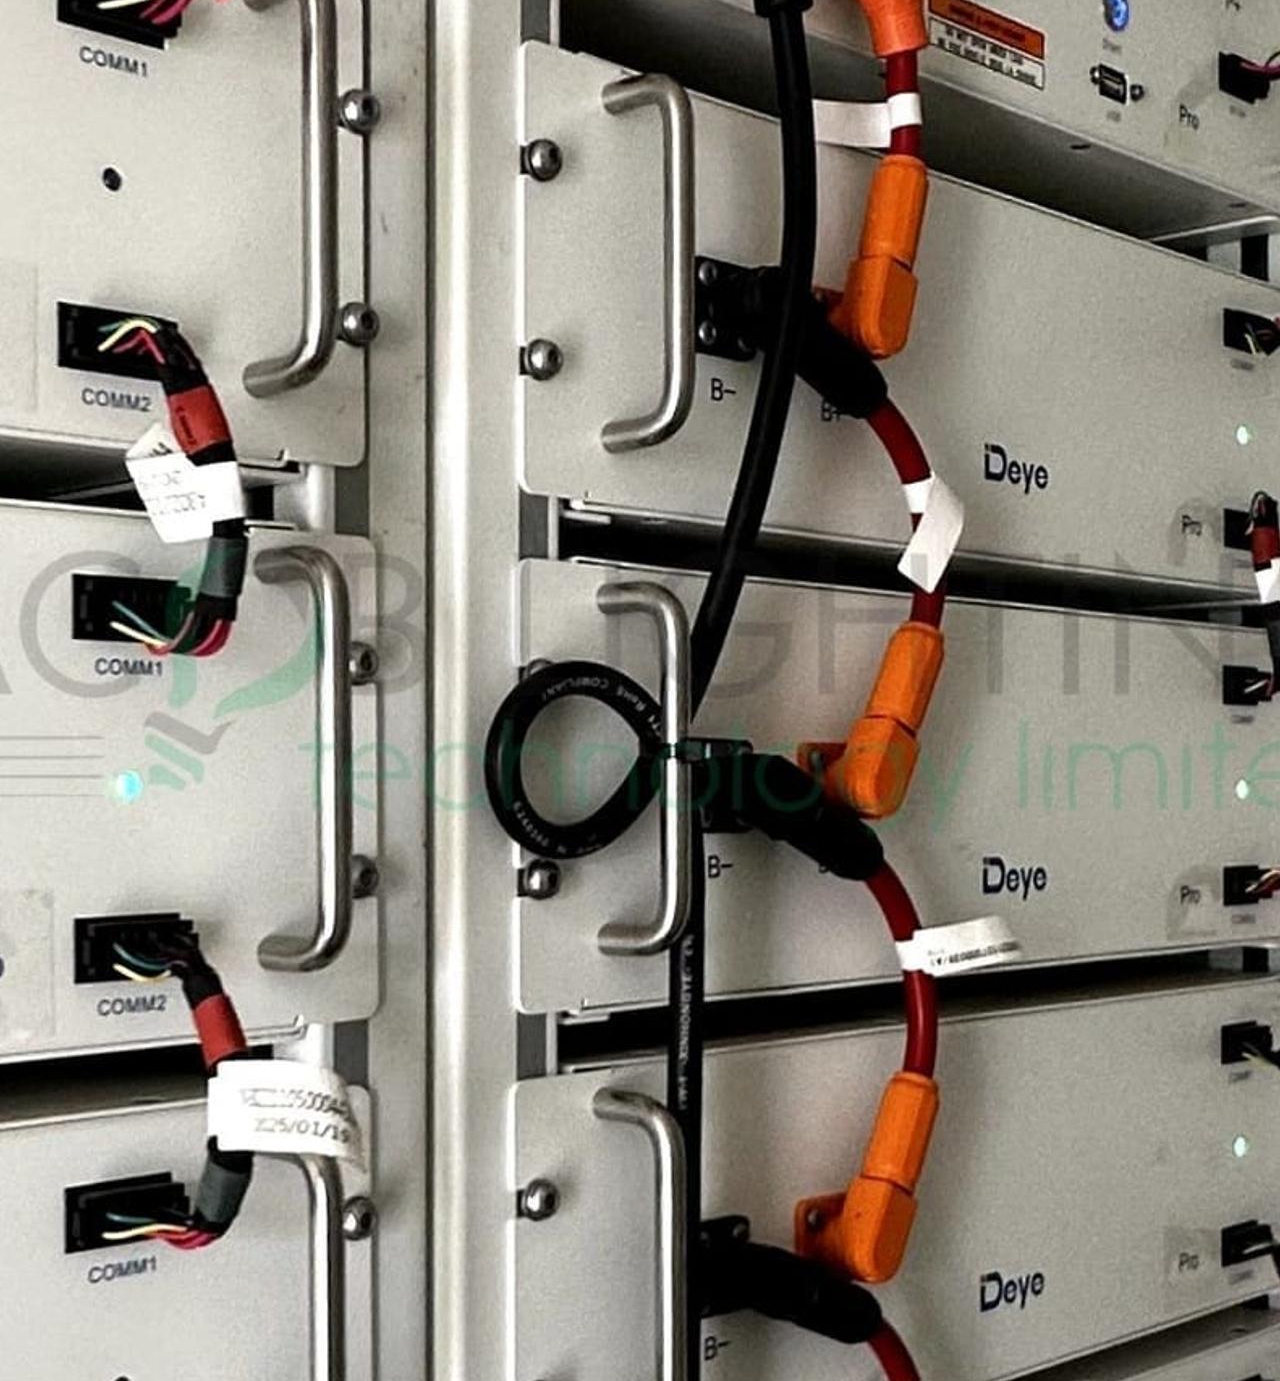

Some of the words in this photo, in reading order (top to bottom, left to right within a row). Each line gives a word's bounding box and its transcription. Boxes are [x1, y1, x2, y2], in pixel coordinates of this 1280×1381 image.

[80, 46, 148, 78] COMM1
[1179, 104, 1199, 130] Pro
[82, 386, 151, 413] COMM2
[985, 443, 1049, 494] Deye
[95, 655, 163, 678] COMM1
[982, 857, 1048, 901] Deye
[1180, 886, 1202, 906] Pro
[97, 994, 167, 1016] COMM2
[88, 1257, 157, 1284] COMM1
[979, 1268, 1046, 1314] Deye
